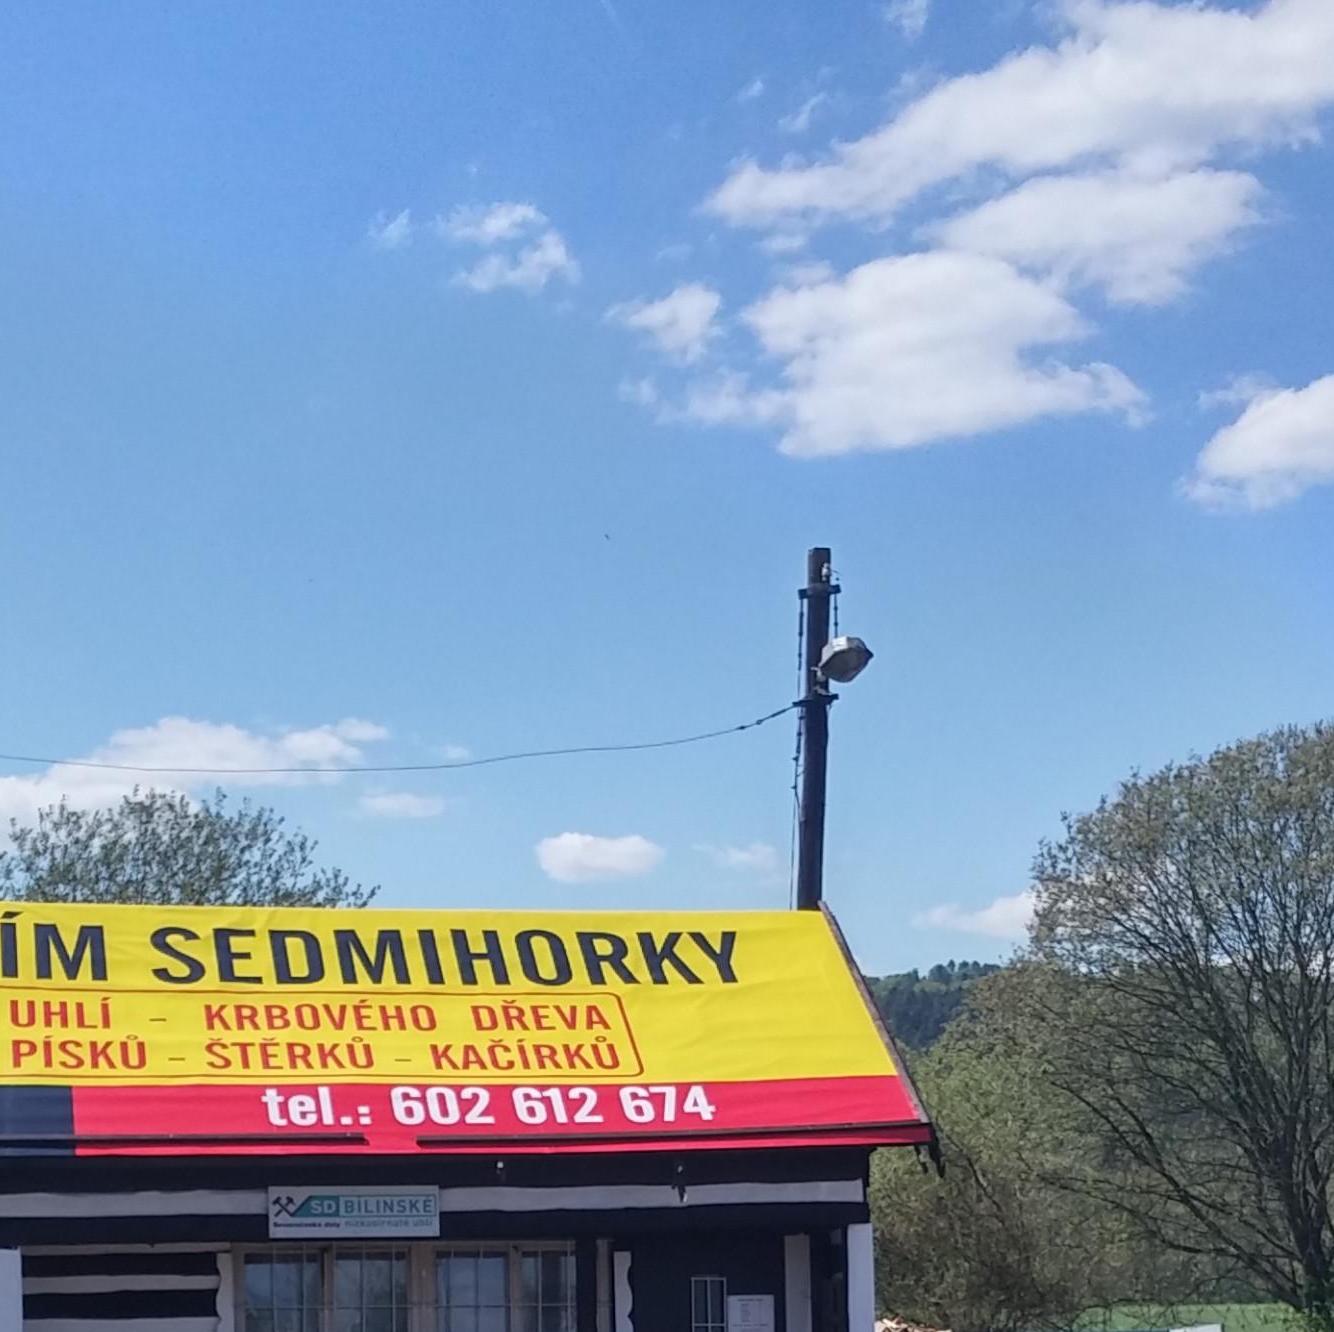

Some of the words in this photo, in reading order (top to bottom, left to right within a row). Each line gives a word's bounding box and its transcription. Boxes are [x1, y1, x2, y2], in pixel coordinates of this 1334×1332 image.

[149, 926, 738, 985] SEDMIHORKY
[9, 996, 112, 1030] UHLÍ
[203, 999, 437, 1031] KRBOVÉHO
[470, 1000, 612, 1031] DŘEVA
[11, 1034, 148, 1070] PÍSKŮ
[204, 1036, 375, 1070] ŠTĚRKŮ
[429, 1035, 621, 1071] KAČÍRKŮ
[261, 1086, 372, 1126] tel.:
[390, 1086, 495, 1126] 602
[511, 1086, 604, 1125] 612
[618, 1084, 717, 1124] 674
[310, 1201, 337, 1215] SD
